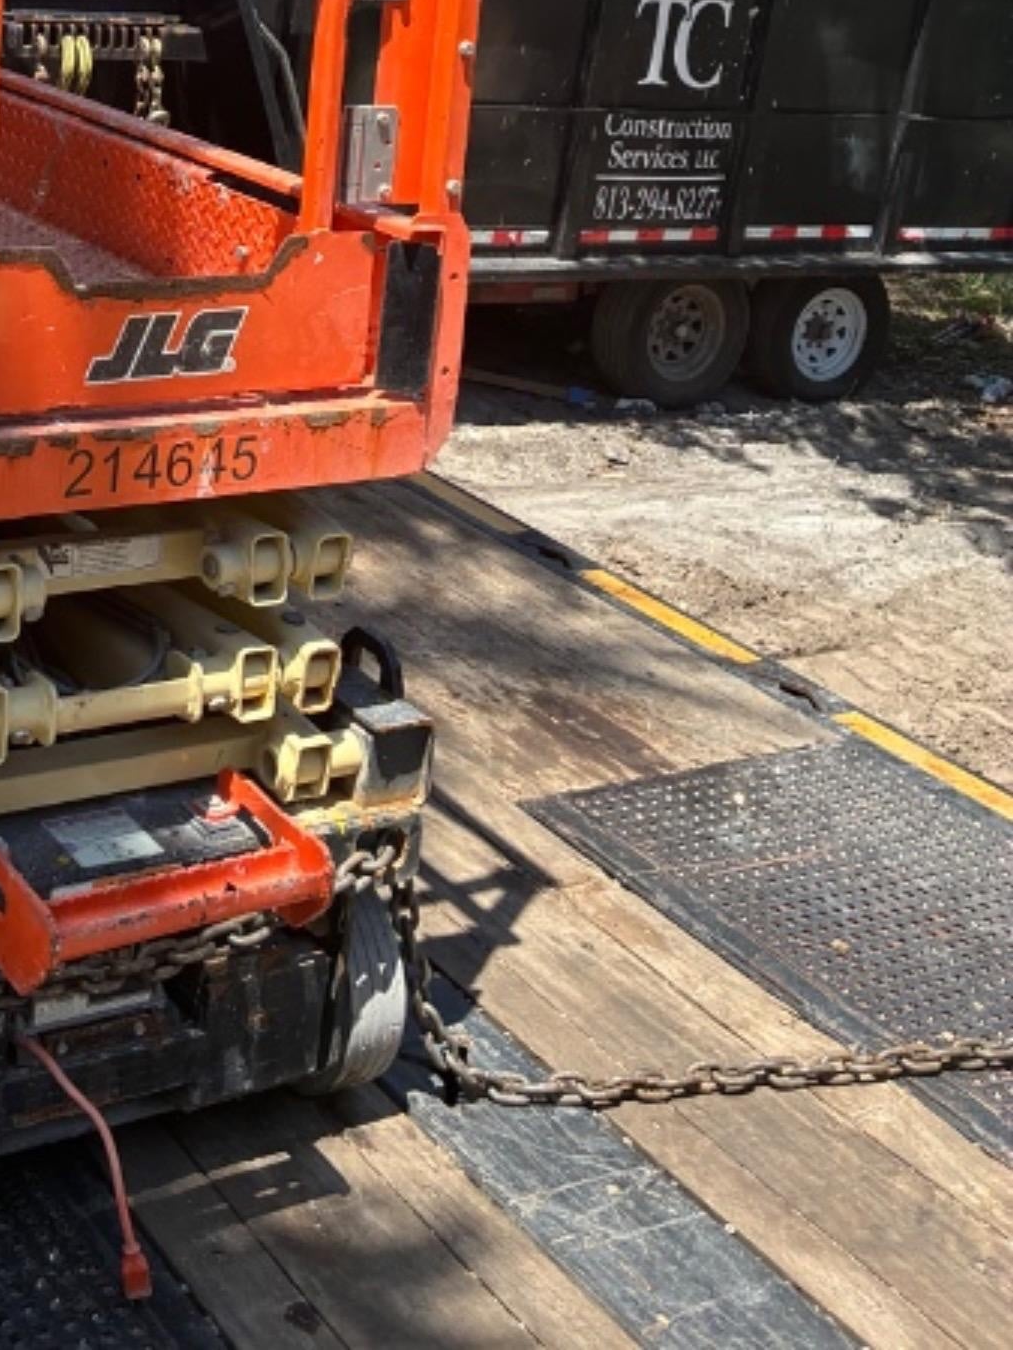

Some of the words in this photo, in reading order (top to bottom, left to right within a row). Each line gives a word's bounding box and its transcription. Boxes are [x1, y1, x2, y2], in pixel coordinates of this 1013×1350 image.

[605, 113, 732, 140] Construction
[86, 306, 249, 385] JLG
[65, 435, 259, 498] 214645
